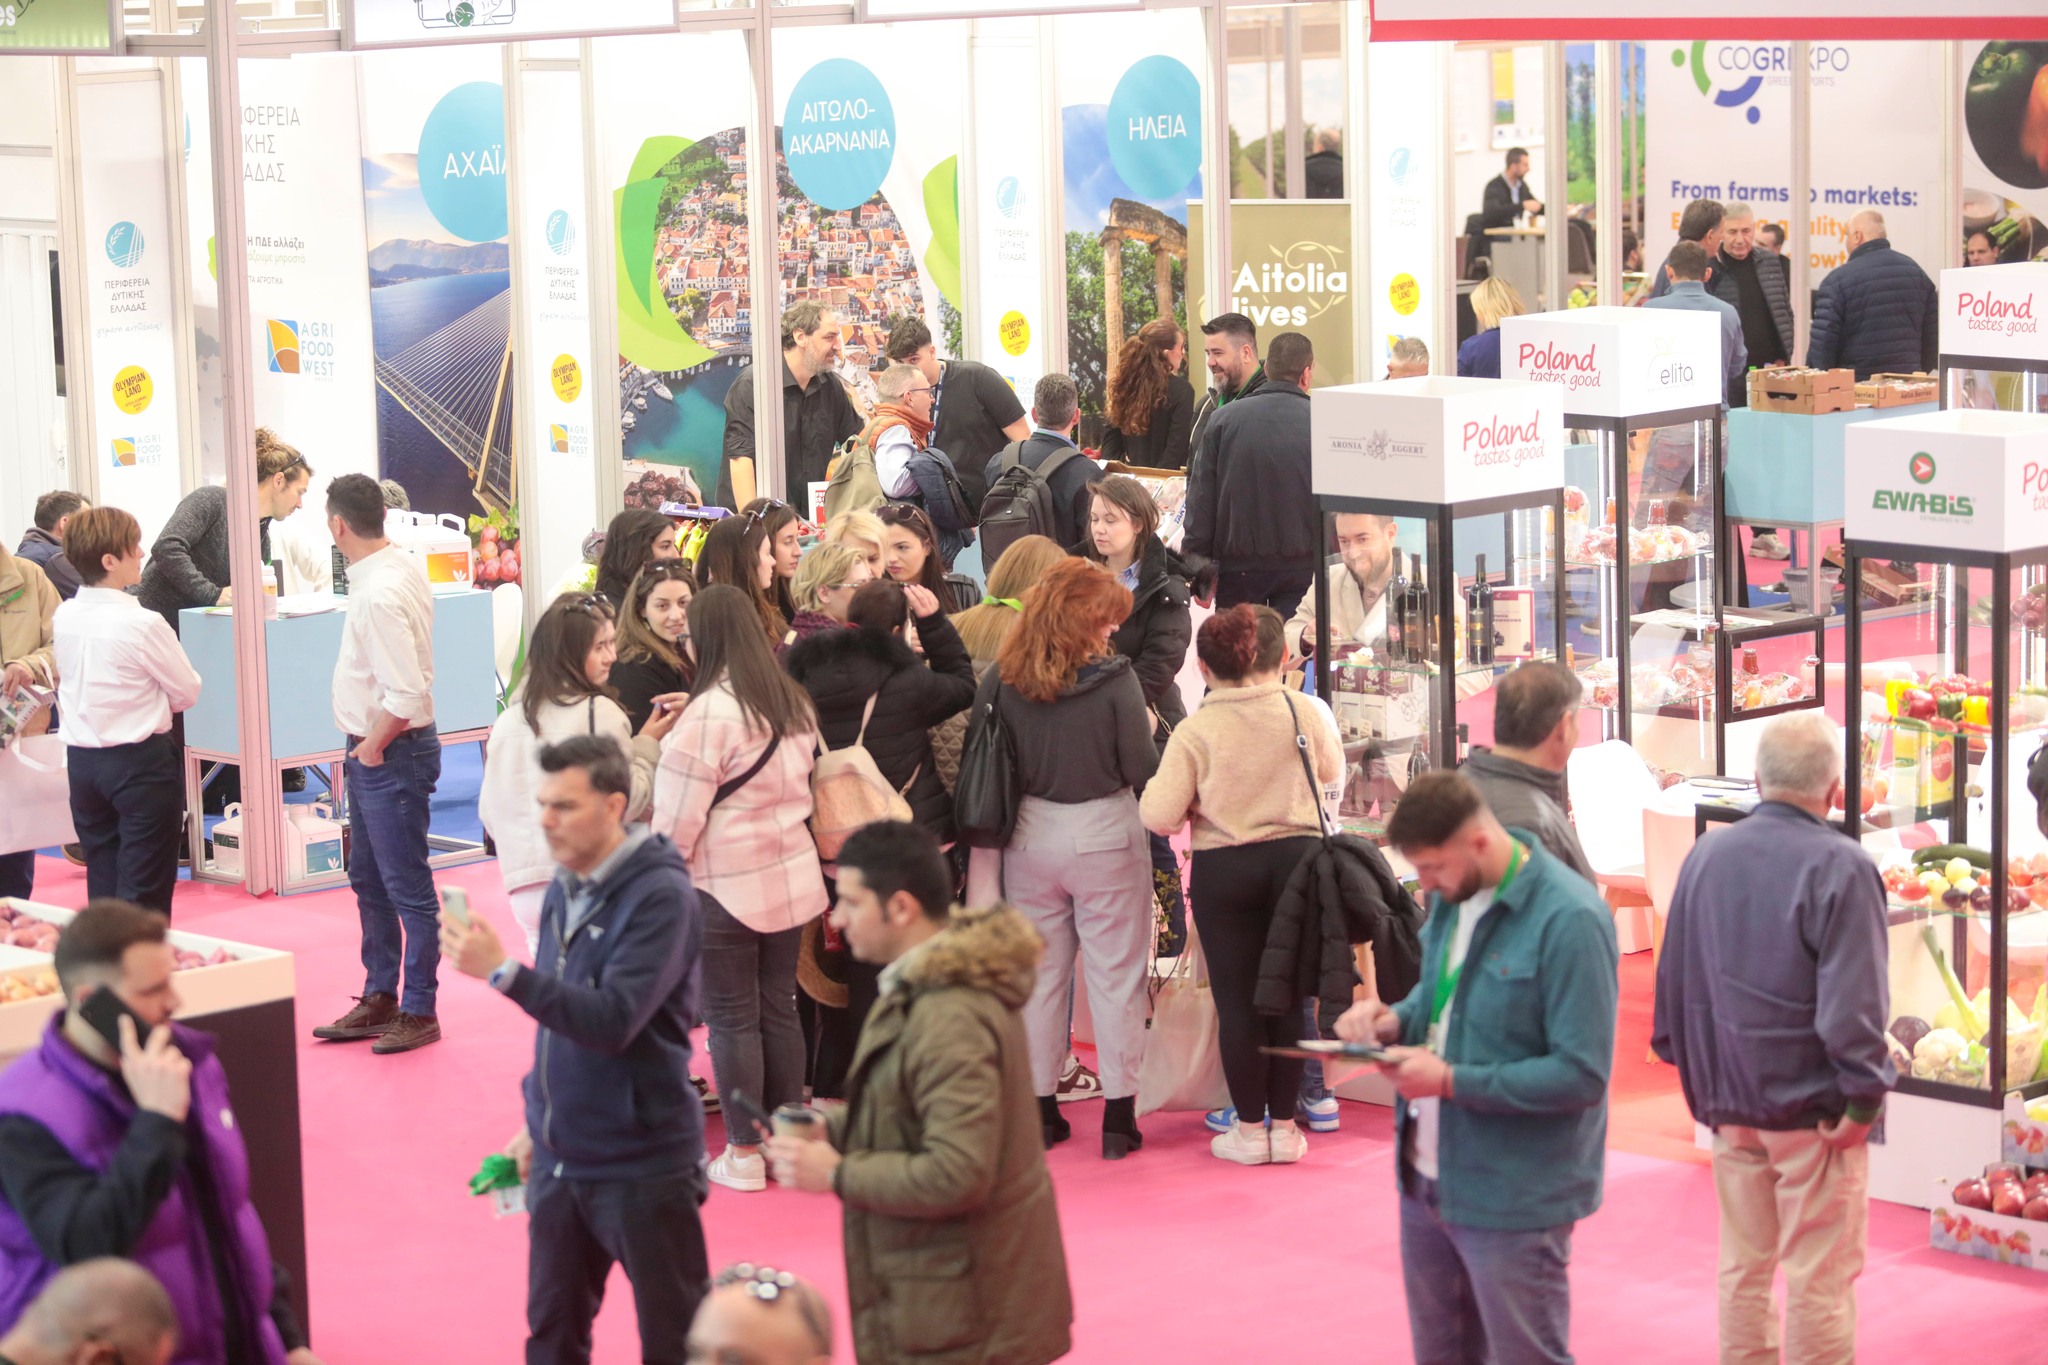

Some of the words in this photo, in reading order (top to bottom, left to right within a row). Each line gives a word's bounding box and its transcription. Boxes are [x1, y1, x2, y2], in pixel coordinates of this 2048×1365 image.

[802, 98, 876, 123] ΑΙΤΩΛΟ-
[1129, 114, 1186, 140] ΗΛΕΙΑ
[789, 128, 890, 156] ΑΚΑΡΝΑΝΙΑ
[443, 144, 506, 179] ΑΧΑΪ
[1672, 180, 1720, 199] From
[1728, 181, 1790, 202] farms
[1825, 185, 1918, 207] markets:
[544, 266, 580, 276] ΠΕΡΙΦΕΡΕΙΑ
[1232, 262, 1348, 292] Aitolia
[104, 278, 151, 289] ΠΕΡΙΦΕΡΕΙΑ
[550, 278, 576, 288] ΔΥΤΙΚΗΣ
[111, 290, 146, 302] ΔΥΤΙΚΗΣ
[549, 290, 578, 301] ΕΛΛΑΔΑΣ
[110, 302, 148, 314] ΕΛΛΑΔΑΣ
[1958, 290, 2033, 319] Poland
[301, 322, 334, 338] AGRI
[1000, 318, 1026, 334] OLYMPIAN
[1008, 328, 1022, 340] LAND
[1968, 316, 2004, 332] tastes
[2006, 318, 2038, 337] good
[301, 340, 334, 357] FOOD
[1519, 341, 1596, 372] Poland
[302, 359, 334, 377] WEST
[552, 362, 577, 378] OLYMPIAN
[1660, 362, 1694, 384] elita
[115, 372, 146, 392] OLYMPIAN
[560, 373, 574, 386] LAND
[1570, 371, 1600, 391] good
[124, 384, 142, 398] LAND
[569, 426, 588, 435] AGRI
[1463, 410, 1540, 452] Poland
[137, 434, 161, 444] AGRI
[569, 436, 588, 445] FOOD
[137, 445, 162, 455] FOOD
[570, 446, 588, 456] WEST
[1331, 440, 1362, 450] ARONIA
[1392, 444, 1424, 455] EGGERT
[1474, 447, 1510, 466] tastes
[1514, 440, 1544, 468] good
[138, 455, 162, 464] WEST
